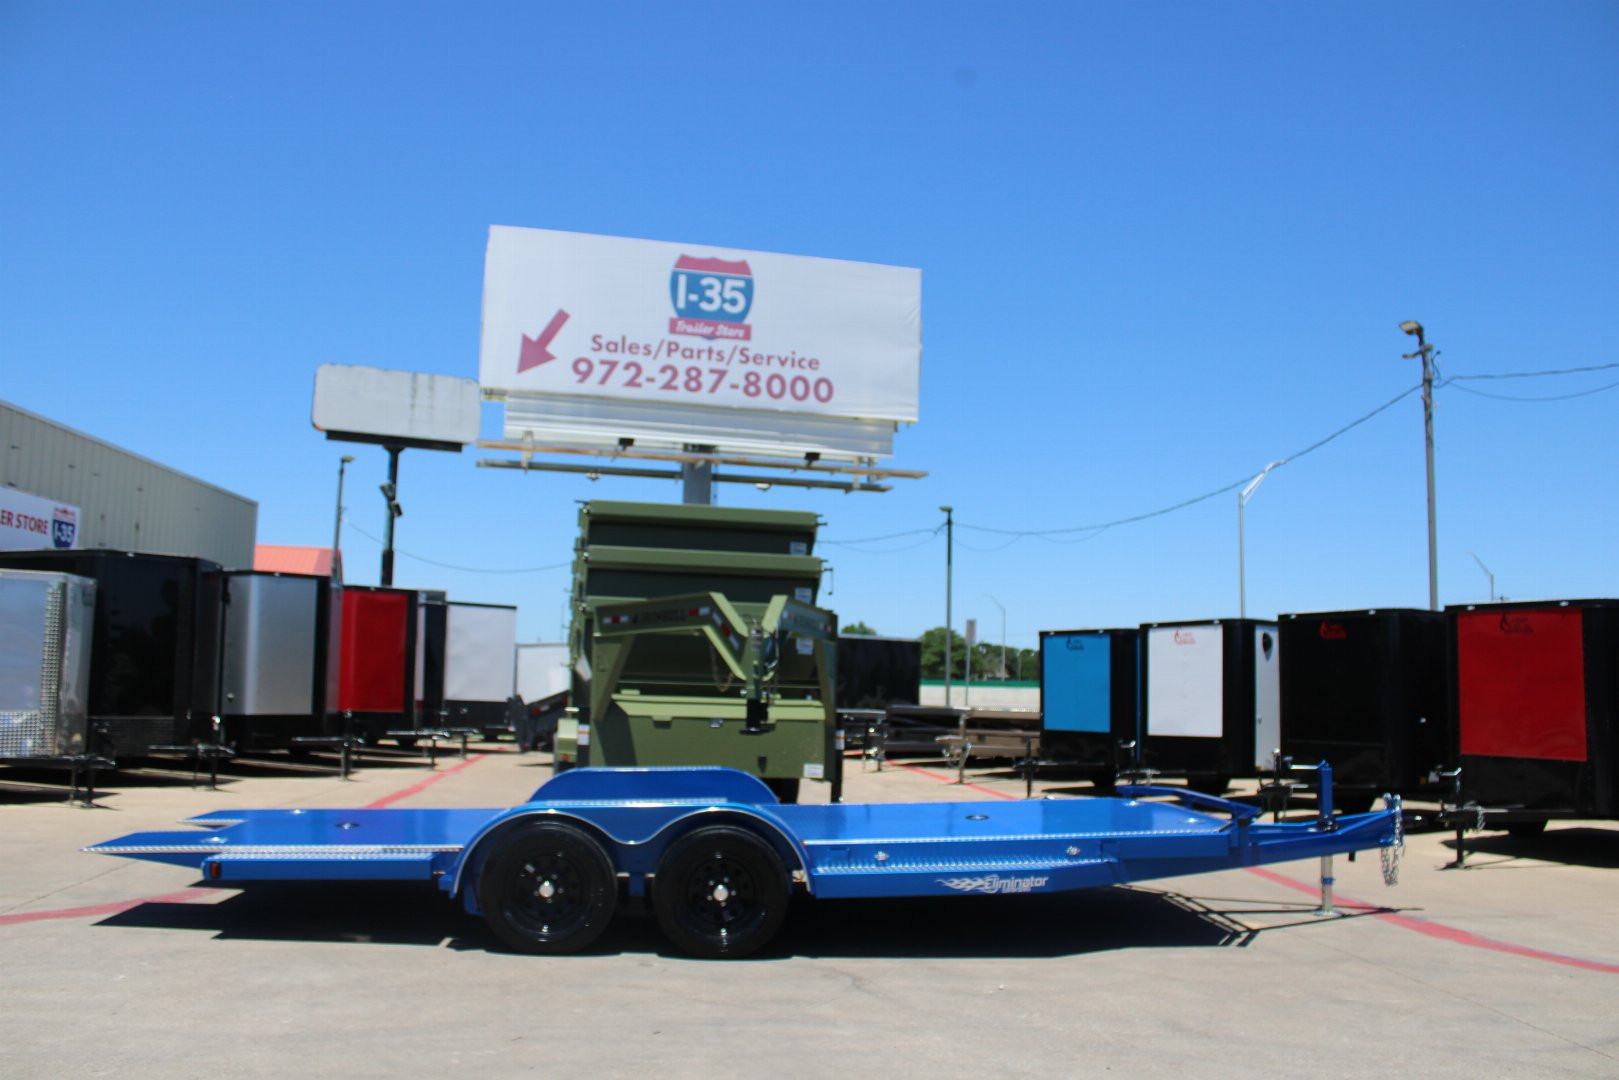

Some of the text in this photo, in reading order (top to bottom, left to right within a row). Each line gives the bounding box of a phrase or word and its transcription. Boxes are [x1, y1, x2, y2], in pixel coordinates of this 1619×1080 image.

[677, 274, 746, 314] I-35
[676, 320, 745, 337] Trailer Store
[591, 335, 820, 370] Sales/Parts/Service
[572, 357, 834, 403] 972-287-8000
[16, 513, 49, 535] STORE
